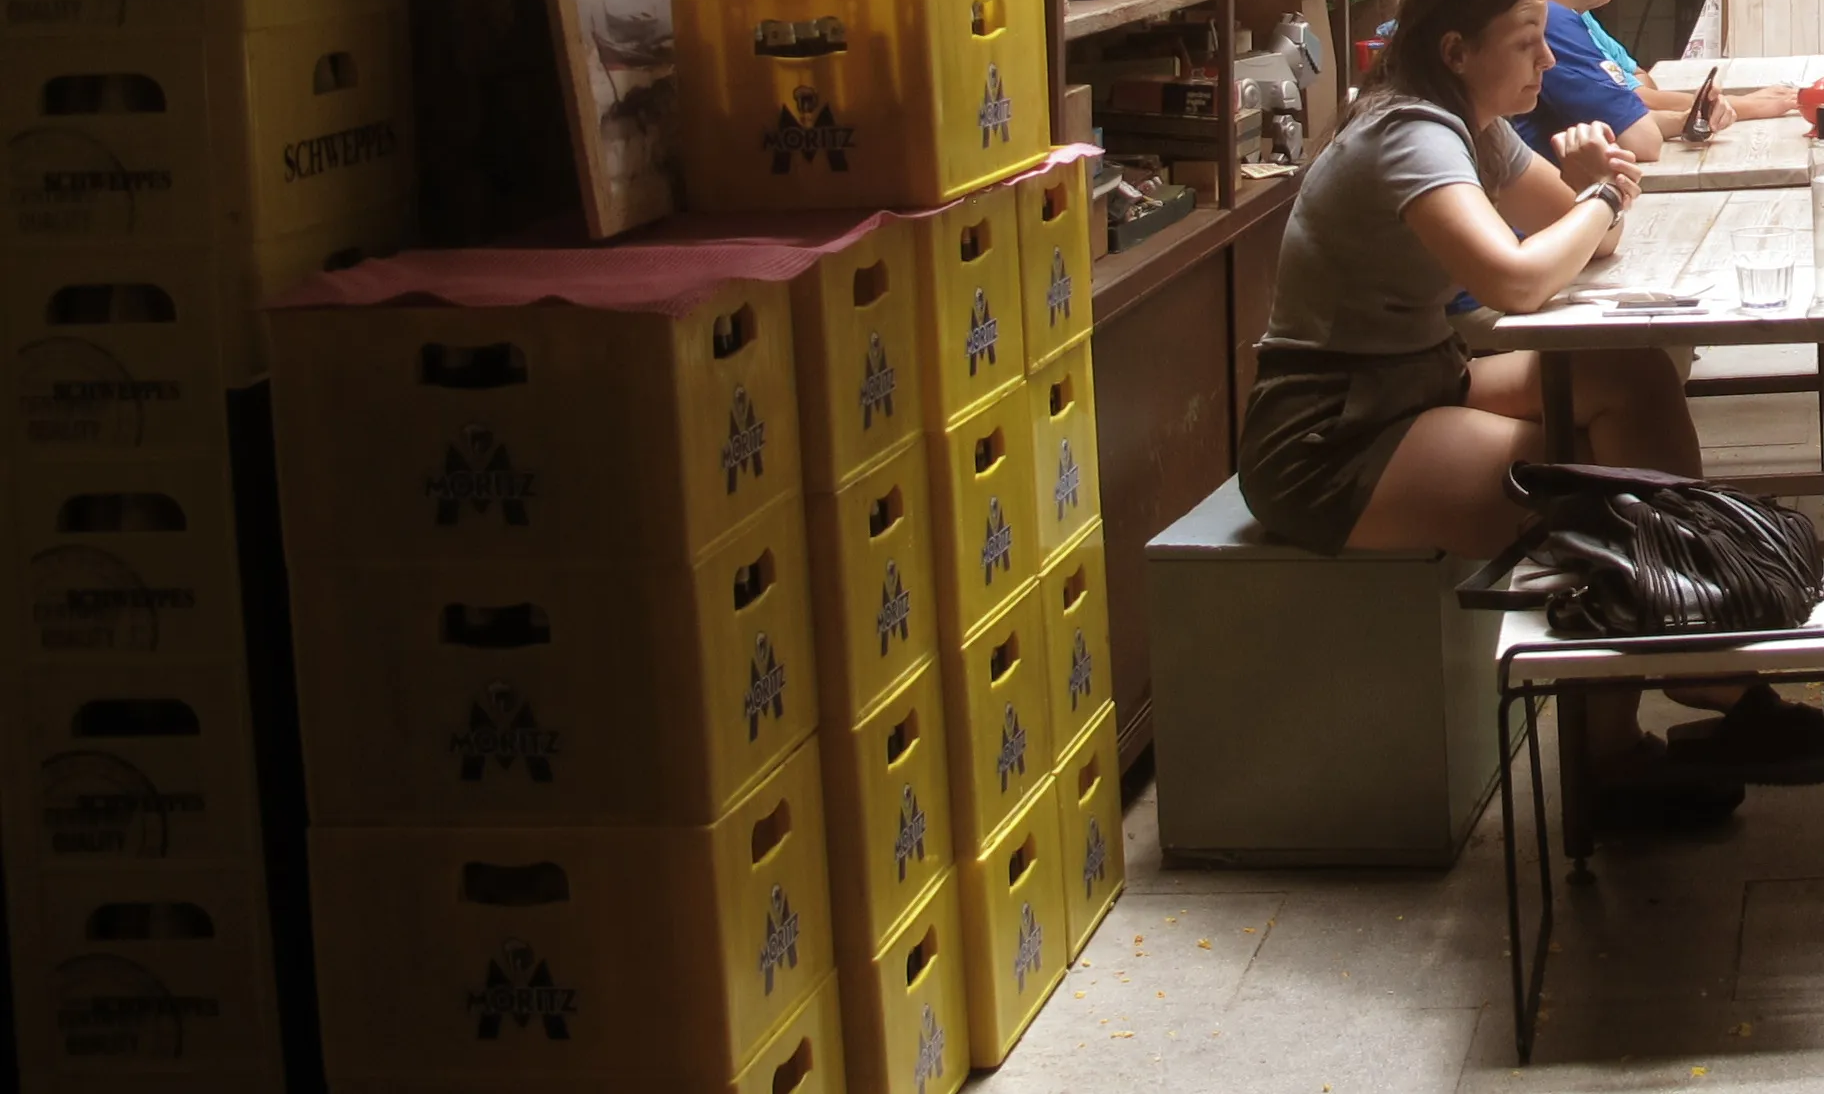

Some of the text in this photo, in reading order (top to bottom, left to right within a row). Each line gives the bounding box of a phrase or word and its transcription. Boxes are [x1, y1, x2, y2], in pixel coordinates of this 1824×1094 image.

[977, 97, 1012, 127] MORITZ
[284, 122, 396, 183] SCHWEPPES
[763, 126, 856, 151] MORITZ
[1047, 275, 1072, 310] MORITZ
[965, 317, 999, 358] MORITZ
[859, 367, 895, 409] MORITZ
[721, 420, 766, 469] MORITZ
[424, 472, 536, 498] MORITZ
[981, 525, 1012, 563] MORITZ
[877, 590, 910, 634] MORITZ
[744, 665, 786, 719] MORITZ
[450, 731, 560, 755] MORITZ
[997, 729, 1028, 770] MORITZ
[894, 817, 926, 860] MORITZ
[760, 919, 800, 970] MORITZ
[466, 989, 578, 1013] MORITZ
